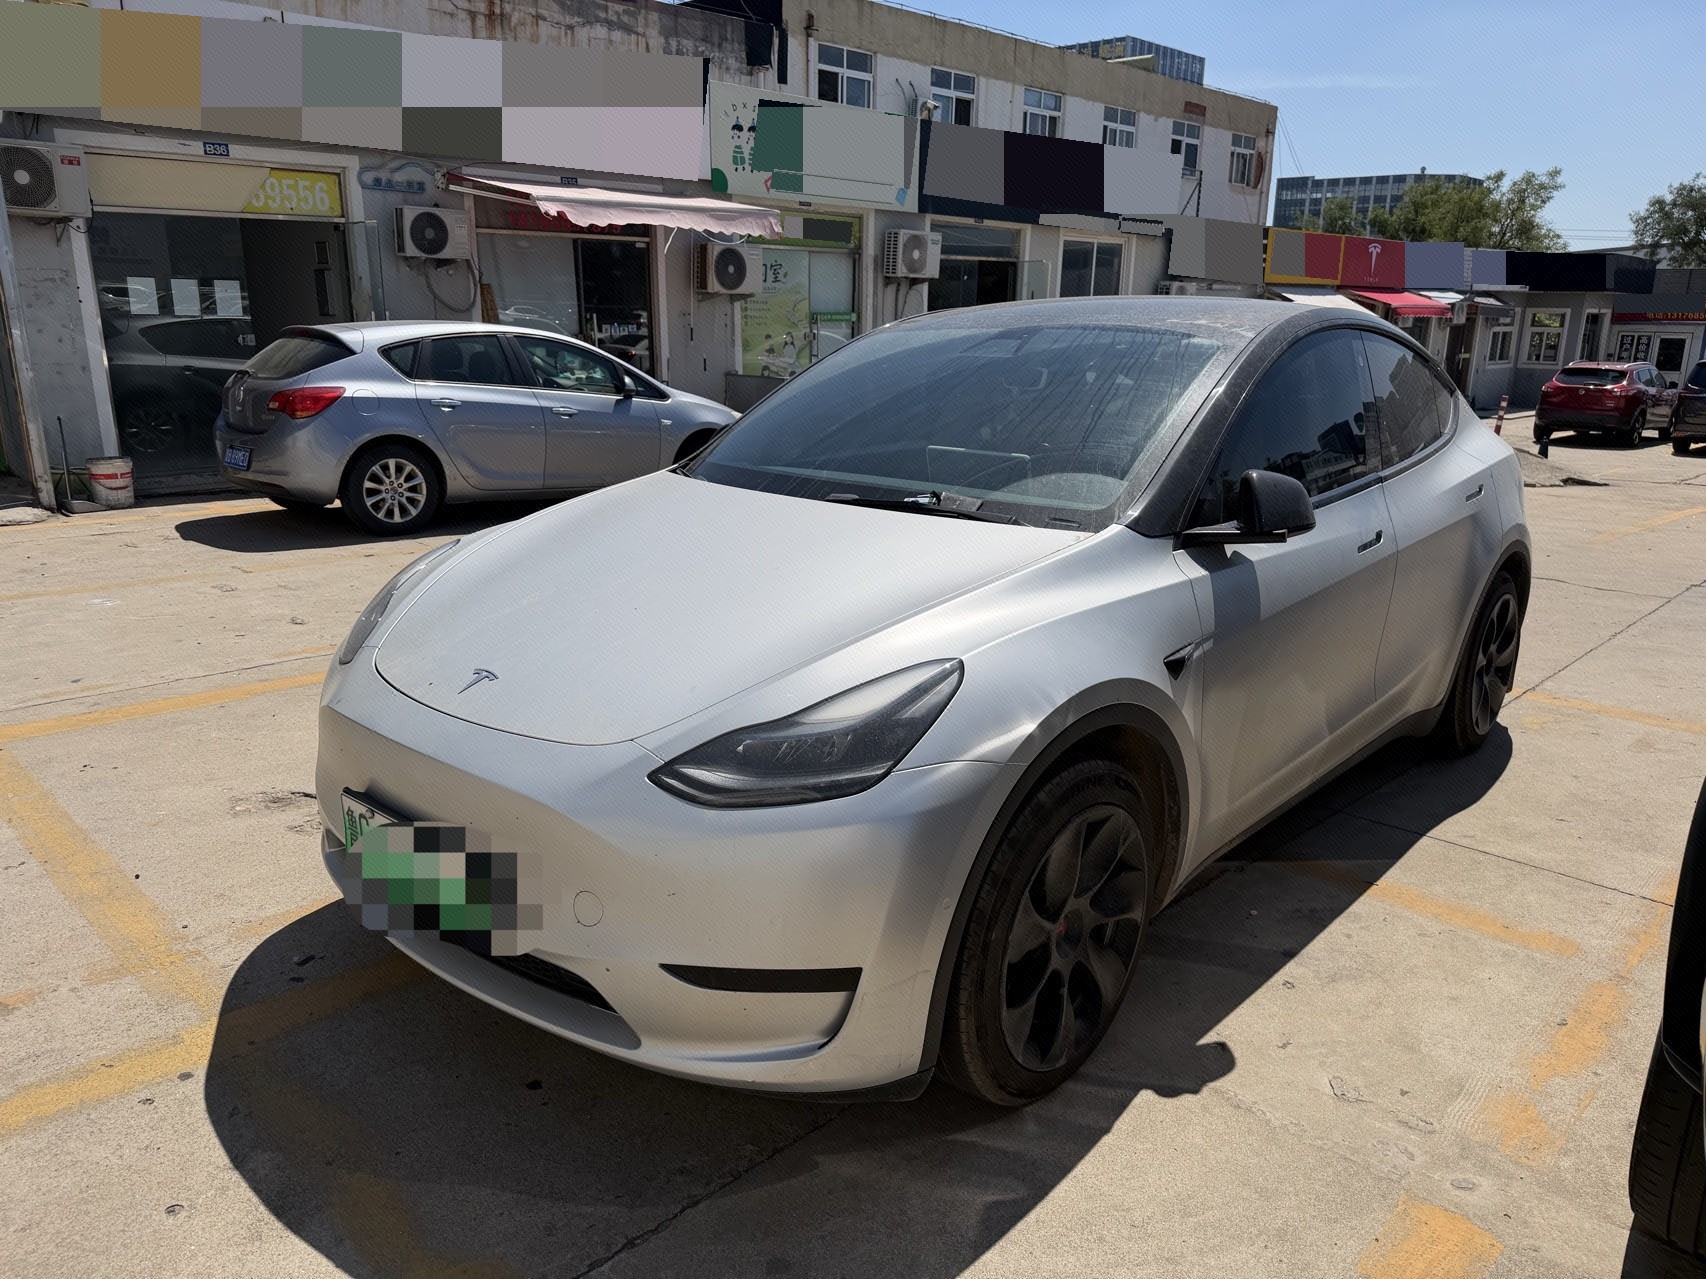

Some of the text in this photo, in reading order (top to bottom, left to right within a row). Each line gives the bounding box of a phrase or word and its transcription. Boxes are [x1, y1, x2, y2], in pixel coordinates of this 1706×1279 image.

[205, 143, 228, 155] B36
[1636, 336, 1648, 361] 高价收
